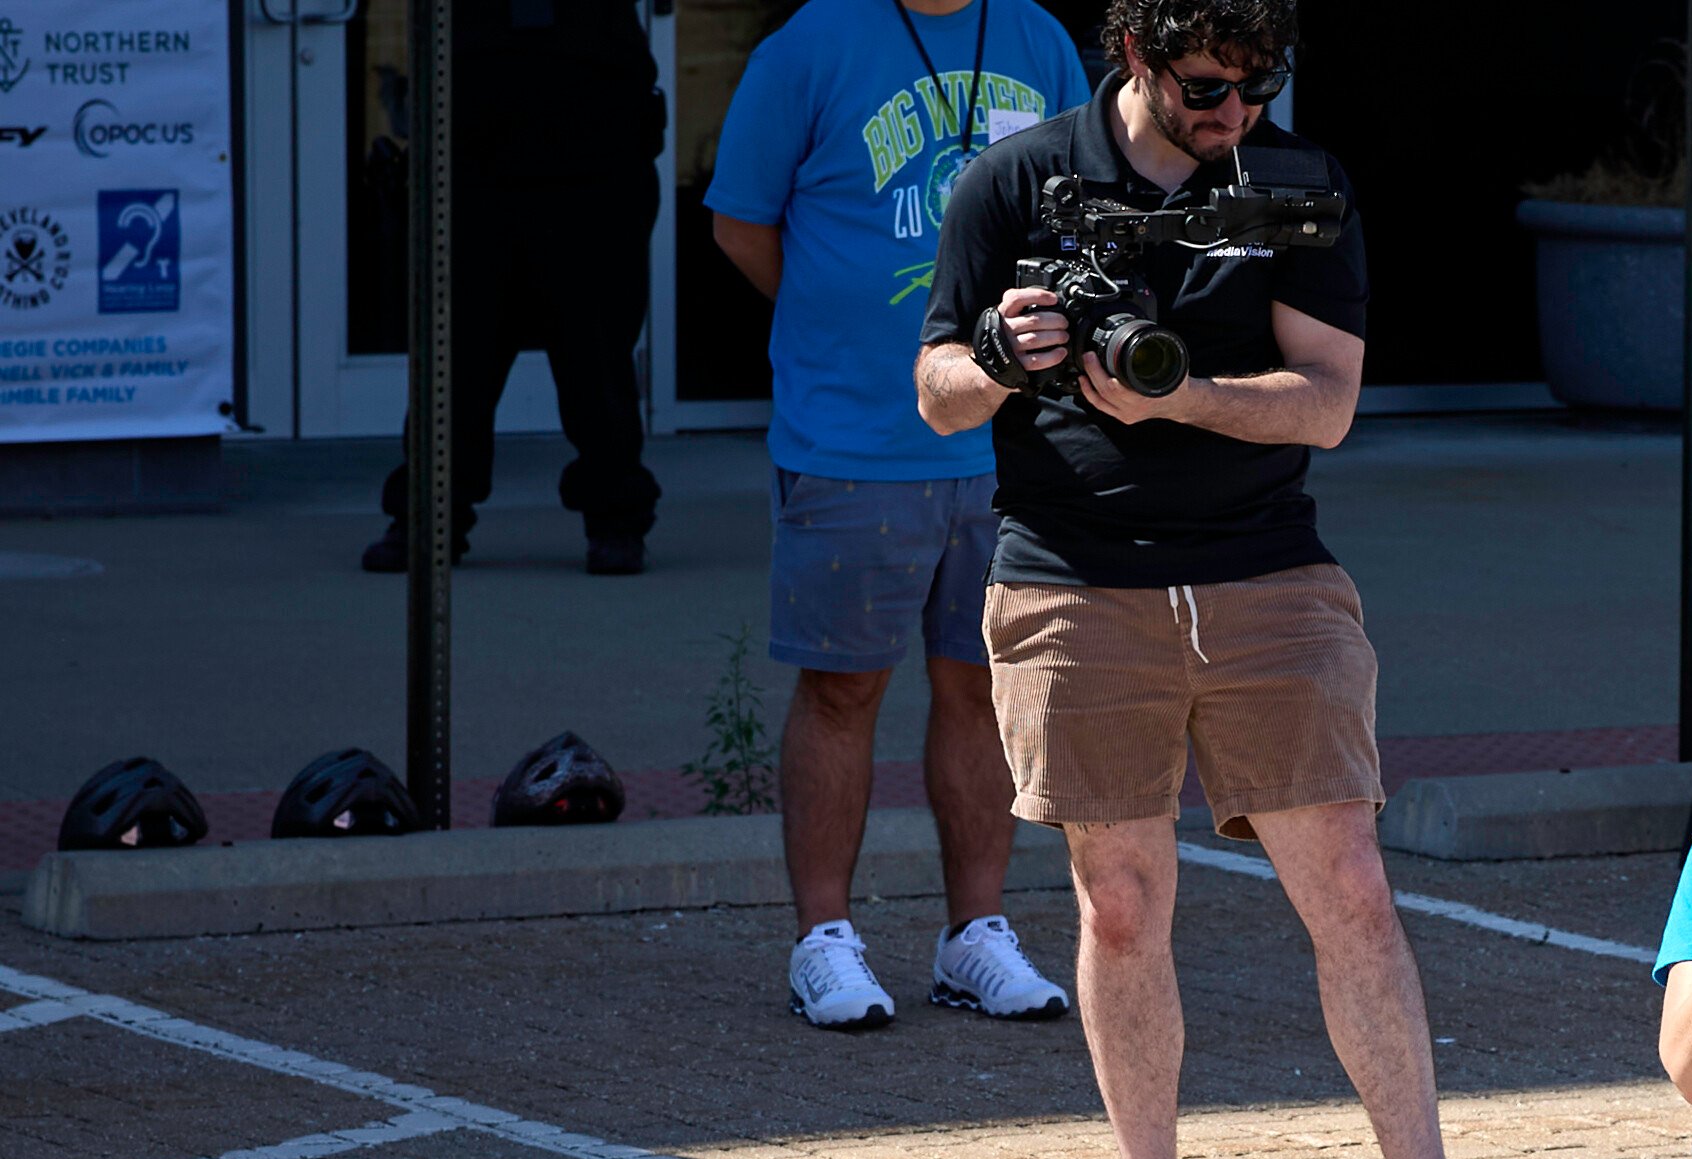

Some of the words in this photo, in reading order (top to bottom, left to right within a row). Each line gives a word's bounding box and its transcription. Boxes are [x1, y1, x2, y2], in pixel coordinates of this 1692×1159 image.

[45, 31, 190, 52] NORTHERN
[46, 62, 130, 84] TRUST
[862, 89, 925, 194] BIG
[0, 207, 68, 248] EVELAND
[0, 340, 46, 358] EGIE
[53, 335, 167, 356] COMPANIES
[119, 360, 190, 377] FAMILY
[0, 388, 59, 404] IMBLE
[66, 386, 137, 402] FAMILY
